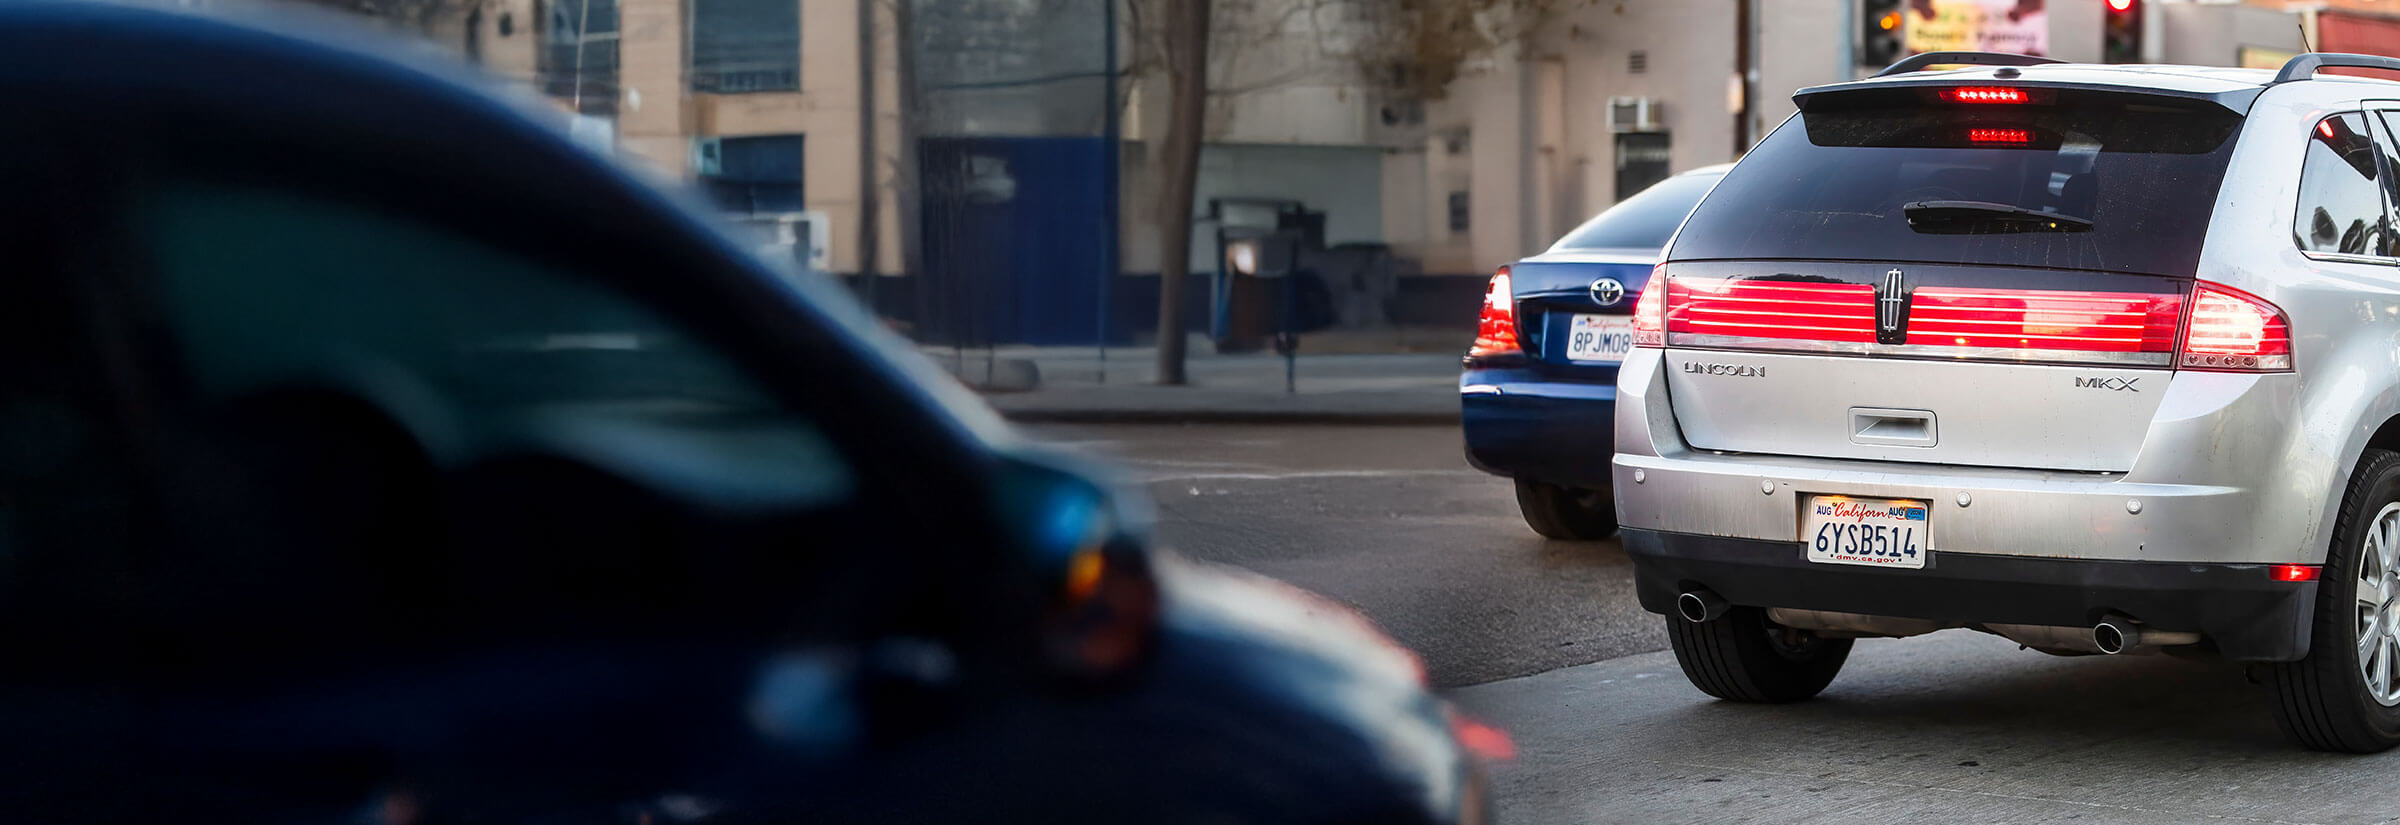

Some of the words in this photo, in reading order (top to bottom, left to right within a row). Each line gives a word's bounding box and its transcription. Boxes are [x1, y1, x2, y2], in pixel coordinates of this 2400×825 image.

[1573, 331, 1631, 354] 8PJM08
[1684, 361, 1765, 377] LINCOLN
[2075, 375, 2140, 392] MKX
[1816, 505, 1832, 516] AUG
[1834, 501, 1892, 523] Californ
[1888, 506, 1905, 517] AUG
[1815, 522, 1917, 558] 6YSB514
[1836, 554, 1896, 564] dmv.ca.gov
